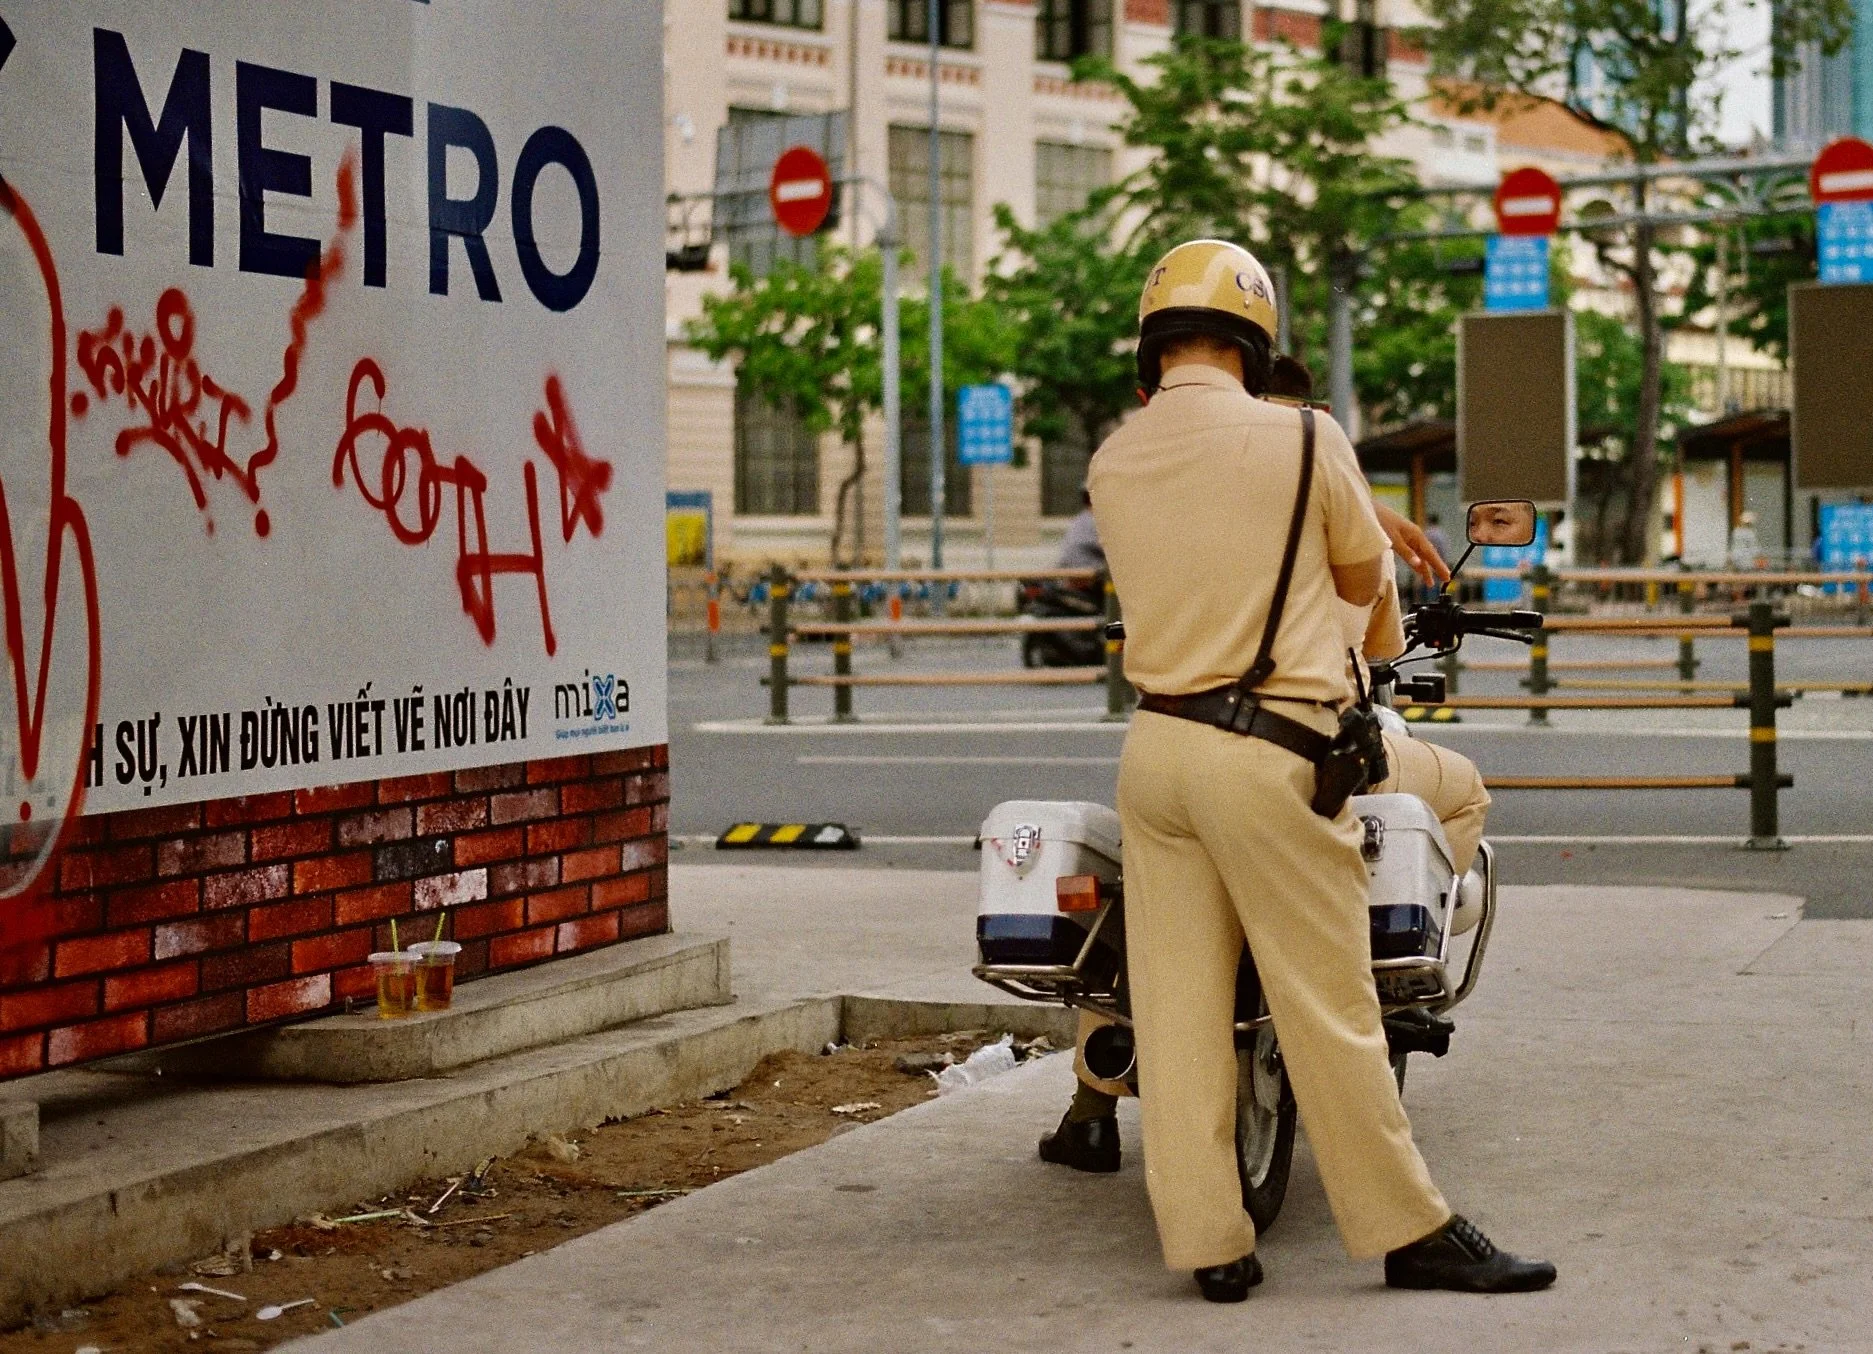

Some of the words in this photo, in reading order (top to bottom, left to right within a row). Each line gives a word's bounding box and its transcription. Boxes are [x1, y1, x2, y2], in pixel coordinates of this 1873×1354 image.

[93, 27, 601, 313] METRO
[115, 711, 168, 797] SỰ,
[177, 712, 231, 778] XIN
[239, 695, 320, 771] ĐỪNG
[327, 681, 386, 761] VIẾT
[393, 684, 426, 753] VẼ
[433, 686, 477, 750] NƠI
[484, 676, 531, 744] ĐÂY
